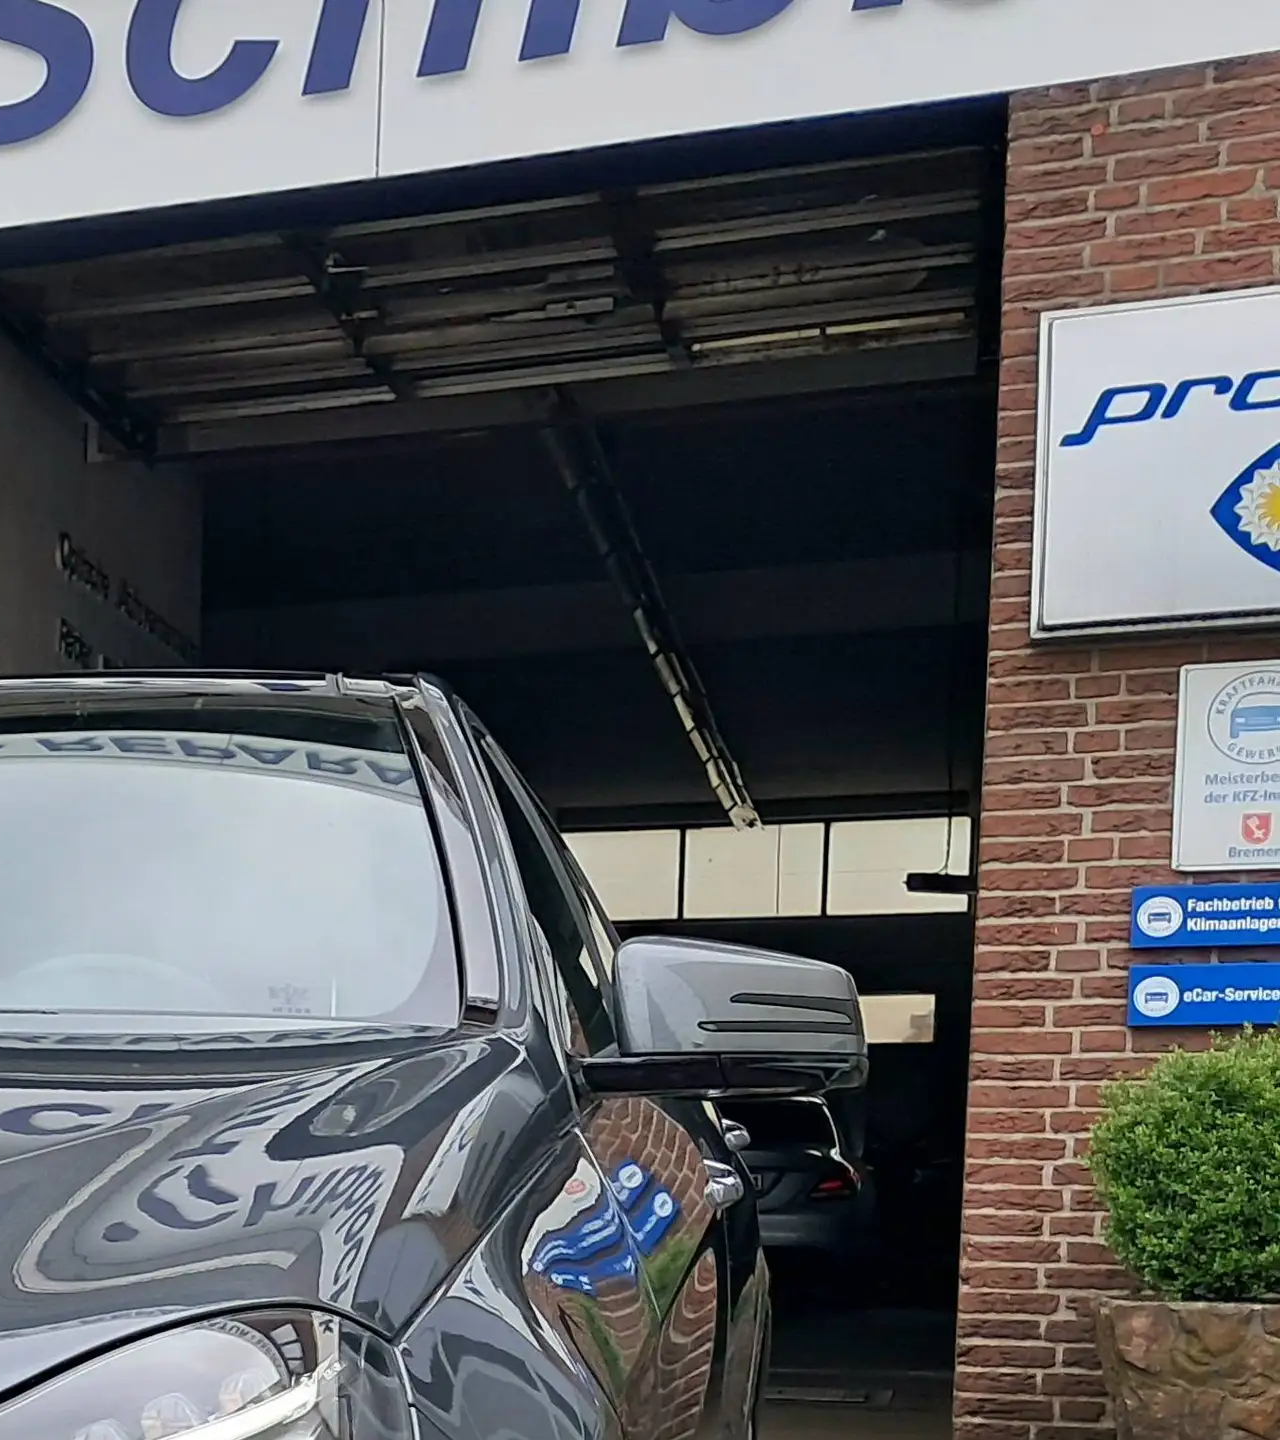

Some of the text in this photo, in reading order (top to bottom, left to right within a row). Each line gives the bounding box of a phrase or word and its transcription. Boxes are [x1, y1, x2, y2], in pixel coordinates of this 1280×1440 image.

[1215, 676, 1280, 716] KRAFTFAH
[1204, 791, 1228, 804] der
[1186, 896, 1274, 912] Fachbetrieb
[1183, 987, 1280, 1002] eCar-Service
